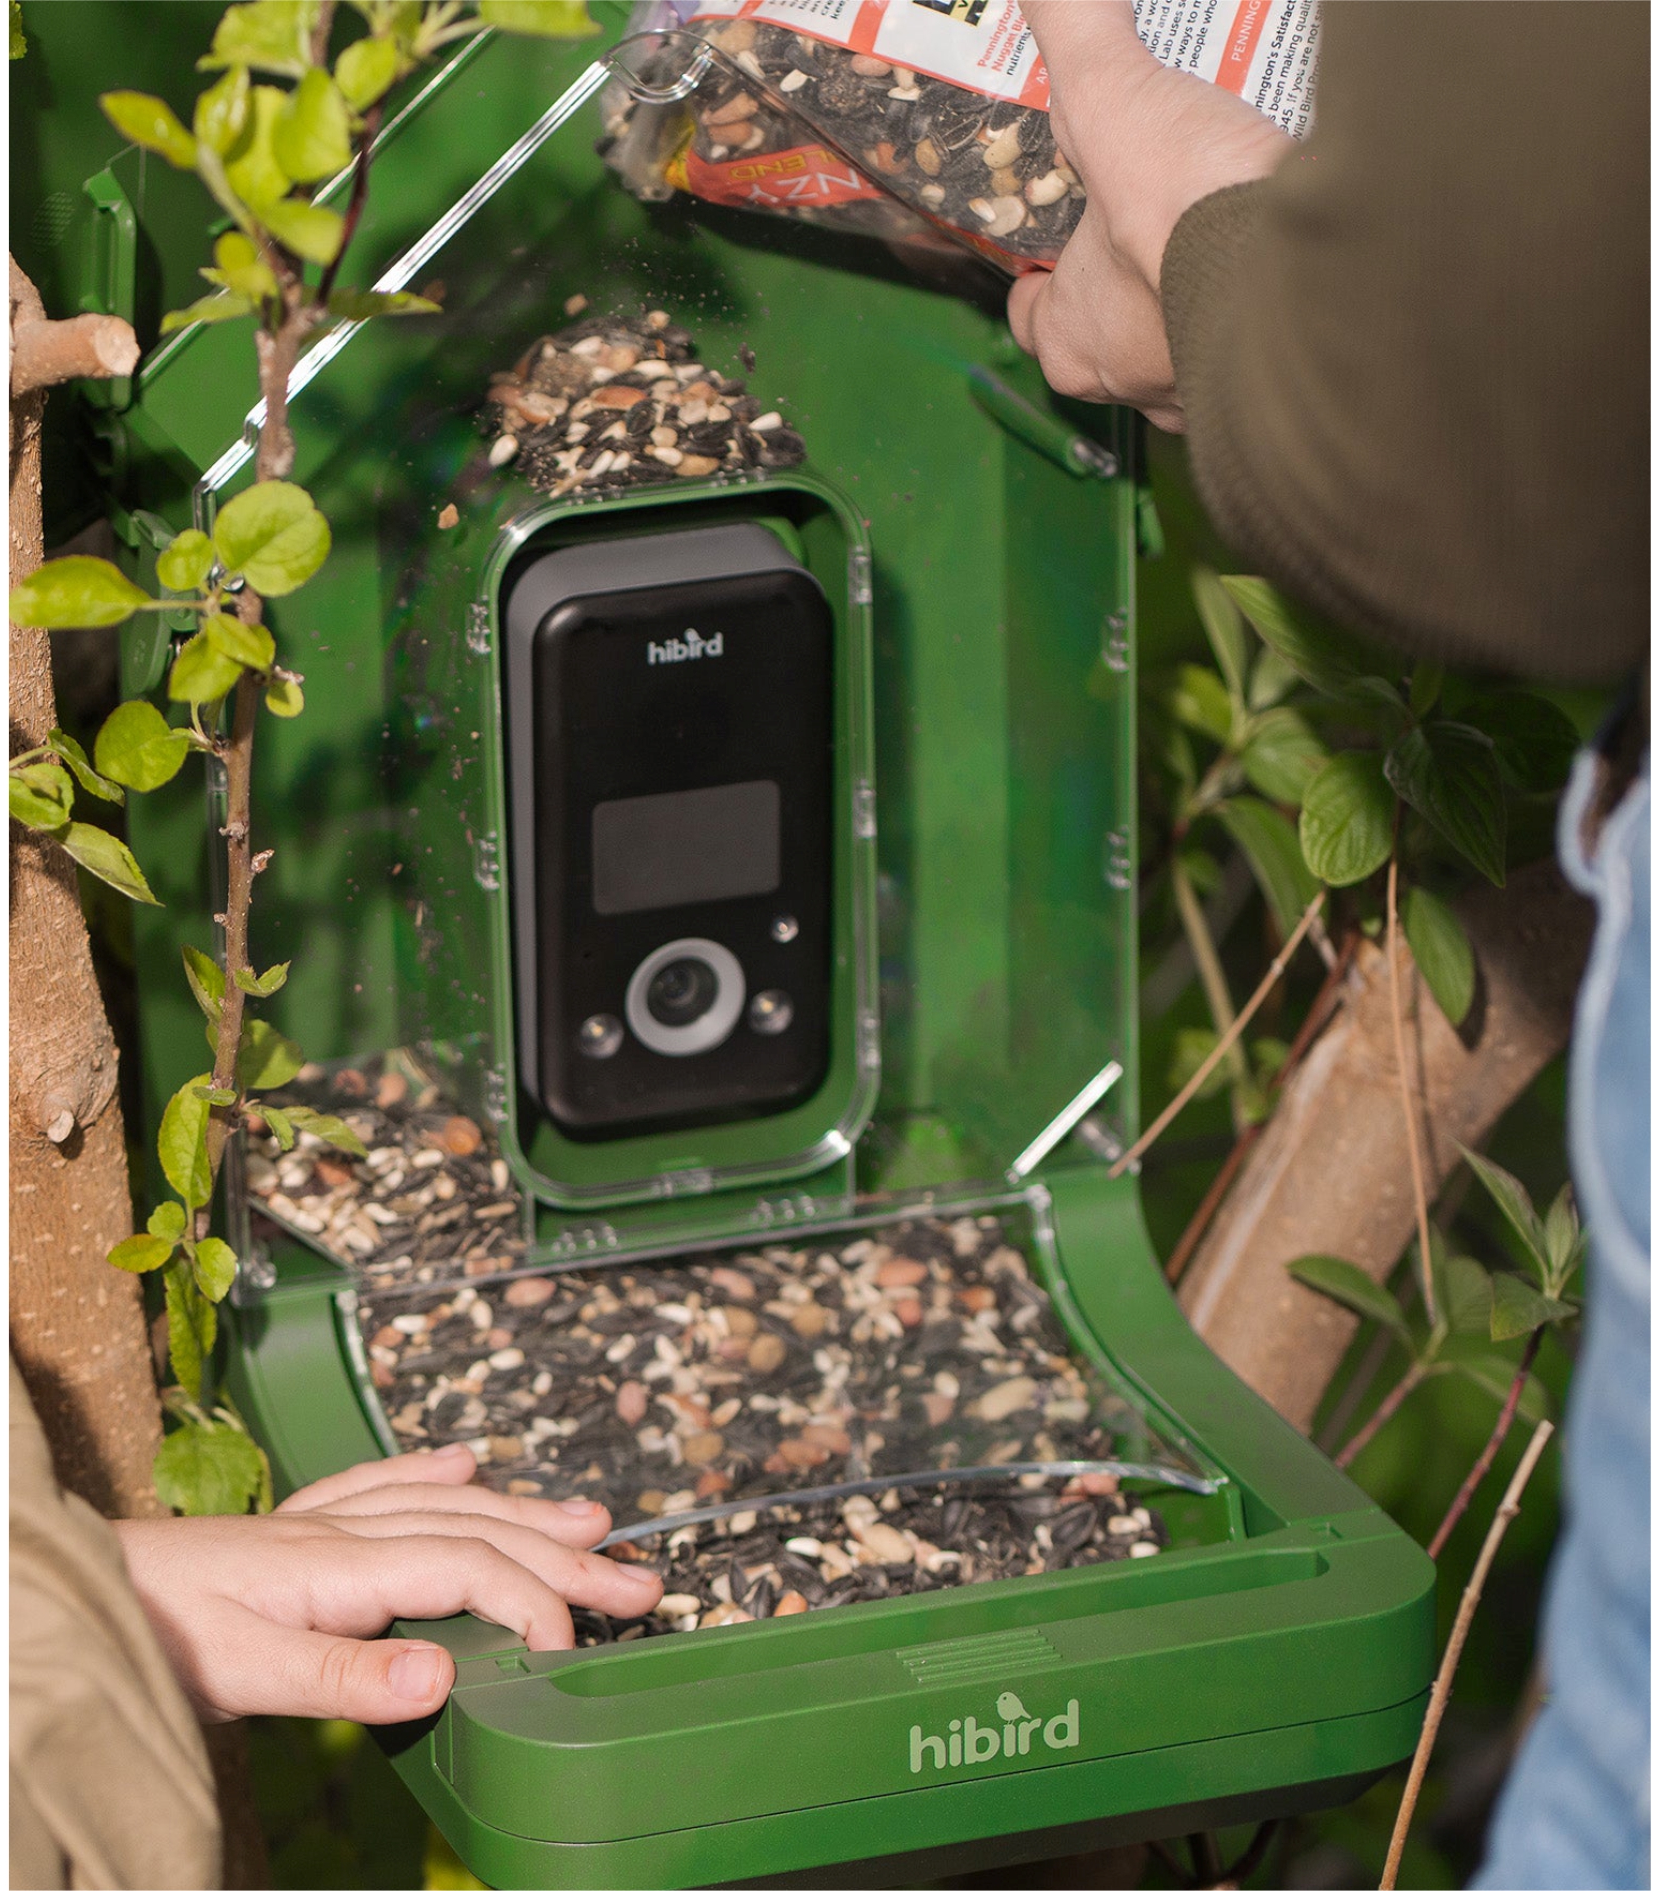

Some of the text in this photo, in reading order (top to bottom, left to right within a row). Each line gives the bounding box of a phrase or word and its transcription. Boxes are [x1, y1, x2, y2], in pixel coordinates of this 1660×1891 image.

[1157, 6, 1170, 28] and
[1158, 39, 1174, 60] Lab
[1169, 11, 1183, 37] uses
[1177, 26, 1193, 55] ways
[1187, 11, 1198, 24] to
[1189, 27, 1208, 68] people
[1203, 0, 1218, 24] who
[991, 32, 1018, 72] Nugget
[1268, 81, 1285, 111] been
[1280, 34, 1303, 78] making
[1286, 93, 1298, 103] If
[1300, 47, 1313, 66] are
[1307, 23, 1320, 44] not
[1255, 51, 1279, 112] nington's
[1300, 87, 1315, 113] Bird
[647, 628, 724, 665] hibird
[909, 1691, 1079, 1773] hibird
